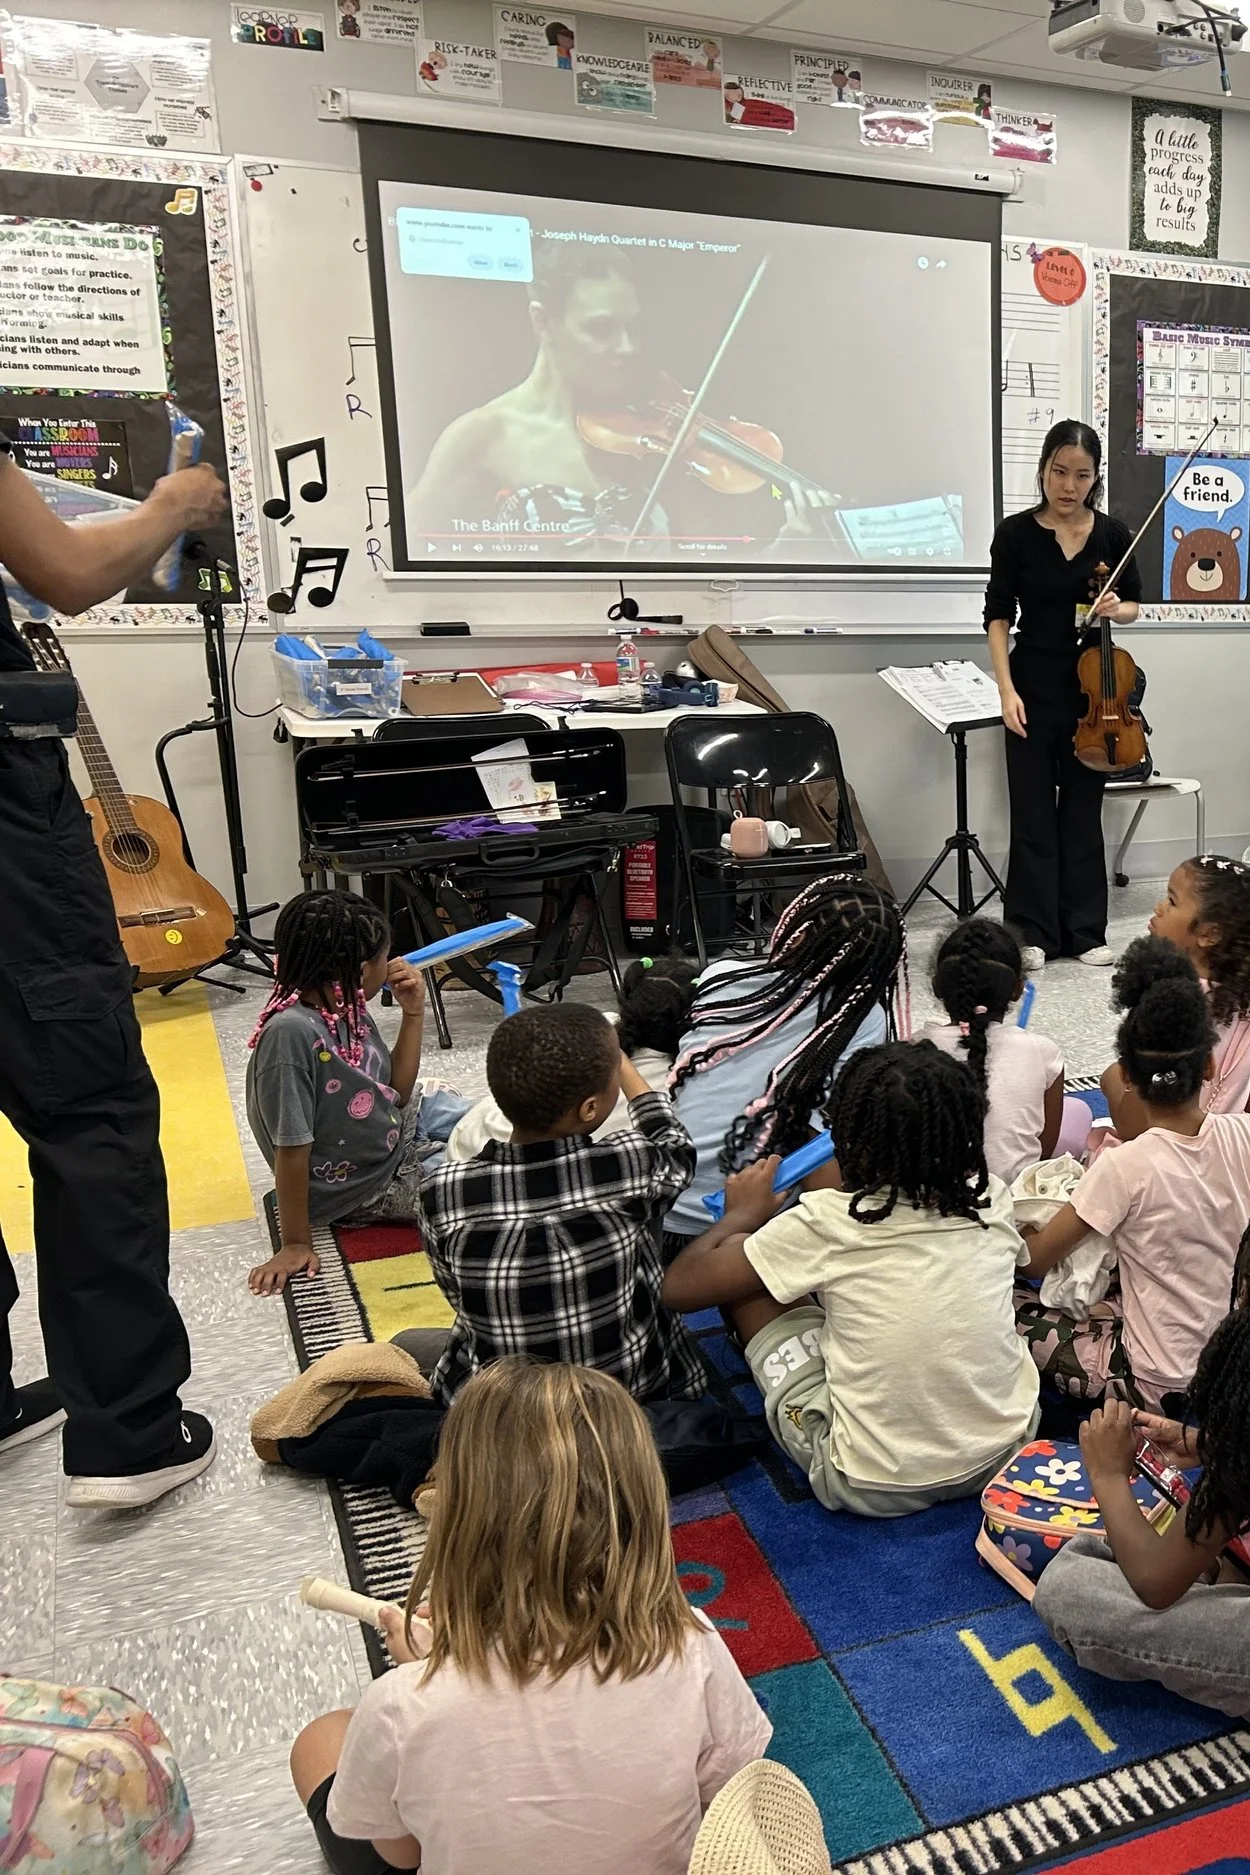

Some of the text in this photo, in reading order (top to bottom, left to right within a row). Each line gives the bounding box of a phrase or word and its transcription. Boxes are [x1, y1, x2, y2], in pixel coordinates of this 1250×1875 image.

[501, 10, 547, 26] CARING
[240, 24, 316, 45] PROFILE
[648, 32, 700, 49] BALANCED
[434, 42, 497, 60] RISK-TAKER
[576, 54, 651, 73] KNOWLEDGEABLE
[794, 55, 850, 71] PRINCIPLED
[738, 76, 792, 92] REFLECTIVE
[931, 76, 974, 92] INQUIRER
[996, 113, 1033, 127] THINKER
[1155, 129, 1199, 149] A little
[1151, 147, 1204, 165] progress
[1148, 164, 1206, 187] each day
[1154, 181, 1202, 202] adds up
[1160, 197, 1197, 219] to big
[1156, 216, 1196, 231] results
[542, 229, 577, 240] Joseph
[579, 232, 609, 244] Haydn
[611, 235, 646, 246] Quartet
[648, 239, 657, 247] in
[659, 239, 666, 247] C
[668, 240, 695, 251] Major
[697, 241, 741, 253] "Emperor"
[20, 248, 49, 257] listen
[52, 250, 63, 258] to
[66, 252, 98, 261] music.
[22, 266, 38, 274] set
[41, 266, 68, 276] goals
[71, 268, 87, 276] for
[89, 269, 132, 280] practice.
[1047, 262, 1067, 275] LEVEL
[23, 282, 55, 291] follow
[58, 284, 75, 292] the
[77, 285, 127, 296] directions
[130, 288, 140, 297] of
[42, 293, 85, 303] teacher.
[56, 311, 95, 320] musical
[98, 312, 125, 322] skills
[29, 335, 58, 345] listen
[61, 337, 80, 345] and
[82, 338, 111, 348] adapt
[113, 340, 139, 349] when
[20, 345, 42, 354] with
[44, 347, 81, 356] others.
[32, 362, 100, 373] communicate
[102, 365, 141, 376] through
[346, 394, 372, 420] R
[18, 418, 97, 428] When You Enter This
[24, 448, 37, 457] You
[26, 459, 41, 468] You
[57, 468, 97, 480] SINGERS
[1193, 472, 1224, 487] Be a
[1183, 487, 1233, 503] friend.
[452, 519, 570, 532] The Banff Centre
[366, 538, 391, 571] R
